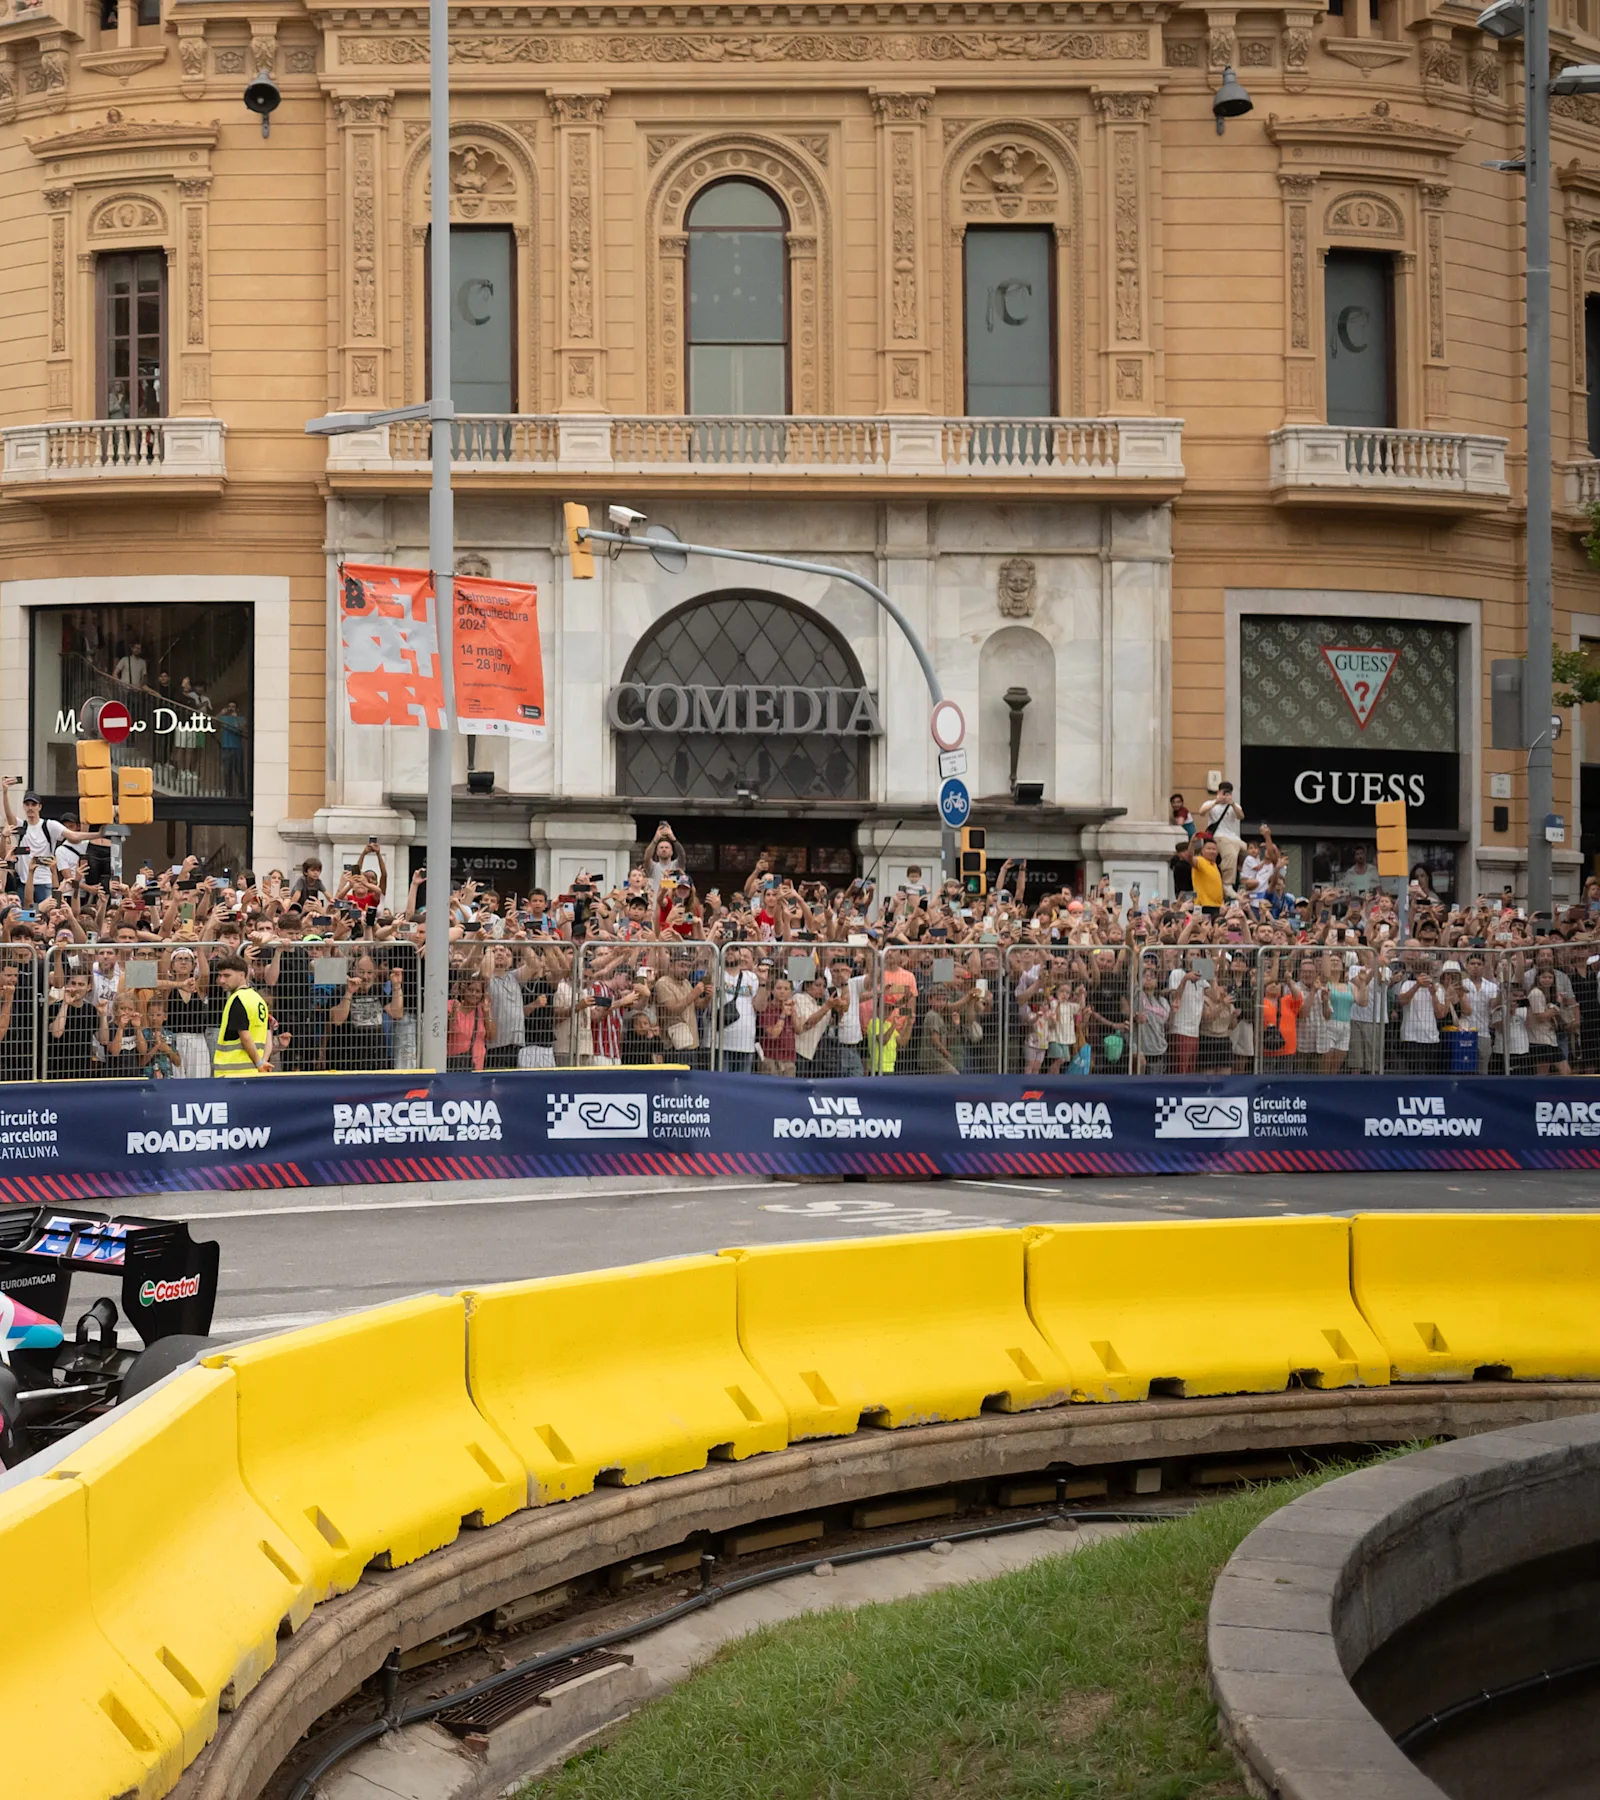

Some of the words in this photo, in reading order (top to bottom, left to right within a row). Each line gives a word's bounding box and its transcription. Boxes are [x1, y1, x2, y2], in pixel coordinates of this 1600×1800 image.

[457, 589, 510, 606] Setmanes
[458, 603, 529, 622] d'Arquitectura
[459, 619, 486, 630] 2024
[461, 644, 473, 655] 14
[477, 646, 503, 659] maig
[476, 659, 491, 670] 28
[493, 660, 511, 675] juny
[1335, 654, 1388, 672] GUESS
[607, 682, 885, 736] COMEDIA
[153, 707, 216, 734] Dutti
[1294, 770, 1425, 807] GUESS
[652, 1094, 692, 1110] Circuit
[694, 1094, 710, 1110] de
[808, 1097, 862, 1116] LIVE
[1253, 1097, 1291, 1111] Circuit
[1293, 1097, 1308, 1111] de
[1398, 1096, 1446, 1115] LIVE
[40, 1108, 58, 1125] de
[170, 1102, 228, 1126] LIVE
[332, 1099, 502, 1129] BARCELONA
[652, 1111, 710, 1125] Barcelona
[955, 1101, 1113, 1125] BARCELONA
[1253, 1112, 1307, 1125] Barcelona
[333, 1126, 373, 1145] FAN
[373, 1124, 455, 1143] FESTIVAL
[456, 1123, 503, 1142] 2024
[653, 1125, 711, 1139] CATALUNYA
[773, 1118, 902, 1139] ROADSHOW
[958, 1124, 993, 1140] FAN
[994, 1124, 1070, 1140] FESTIVAL
[1071, 1124, 1114, 1140] 2024
[1253, 1125, 1309, 1138] CATALUNYA
[1364, 1117, 1483, 1137] ROADSHOW
[1537, 1122, 1567, 1137] FAN
[127, 1126, 271, 1155] ROADSHOW
[0, 1273, 56, 1291] EURODATACAR
[156, 1273, 201, 1302] Castrol
